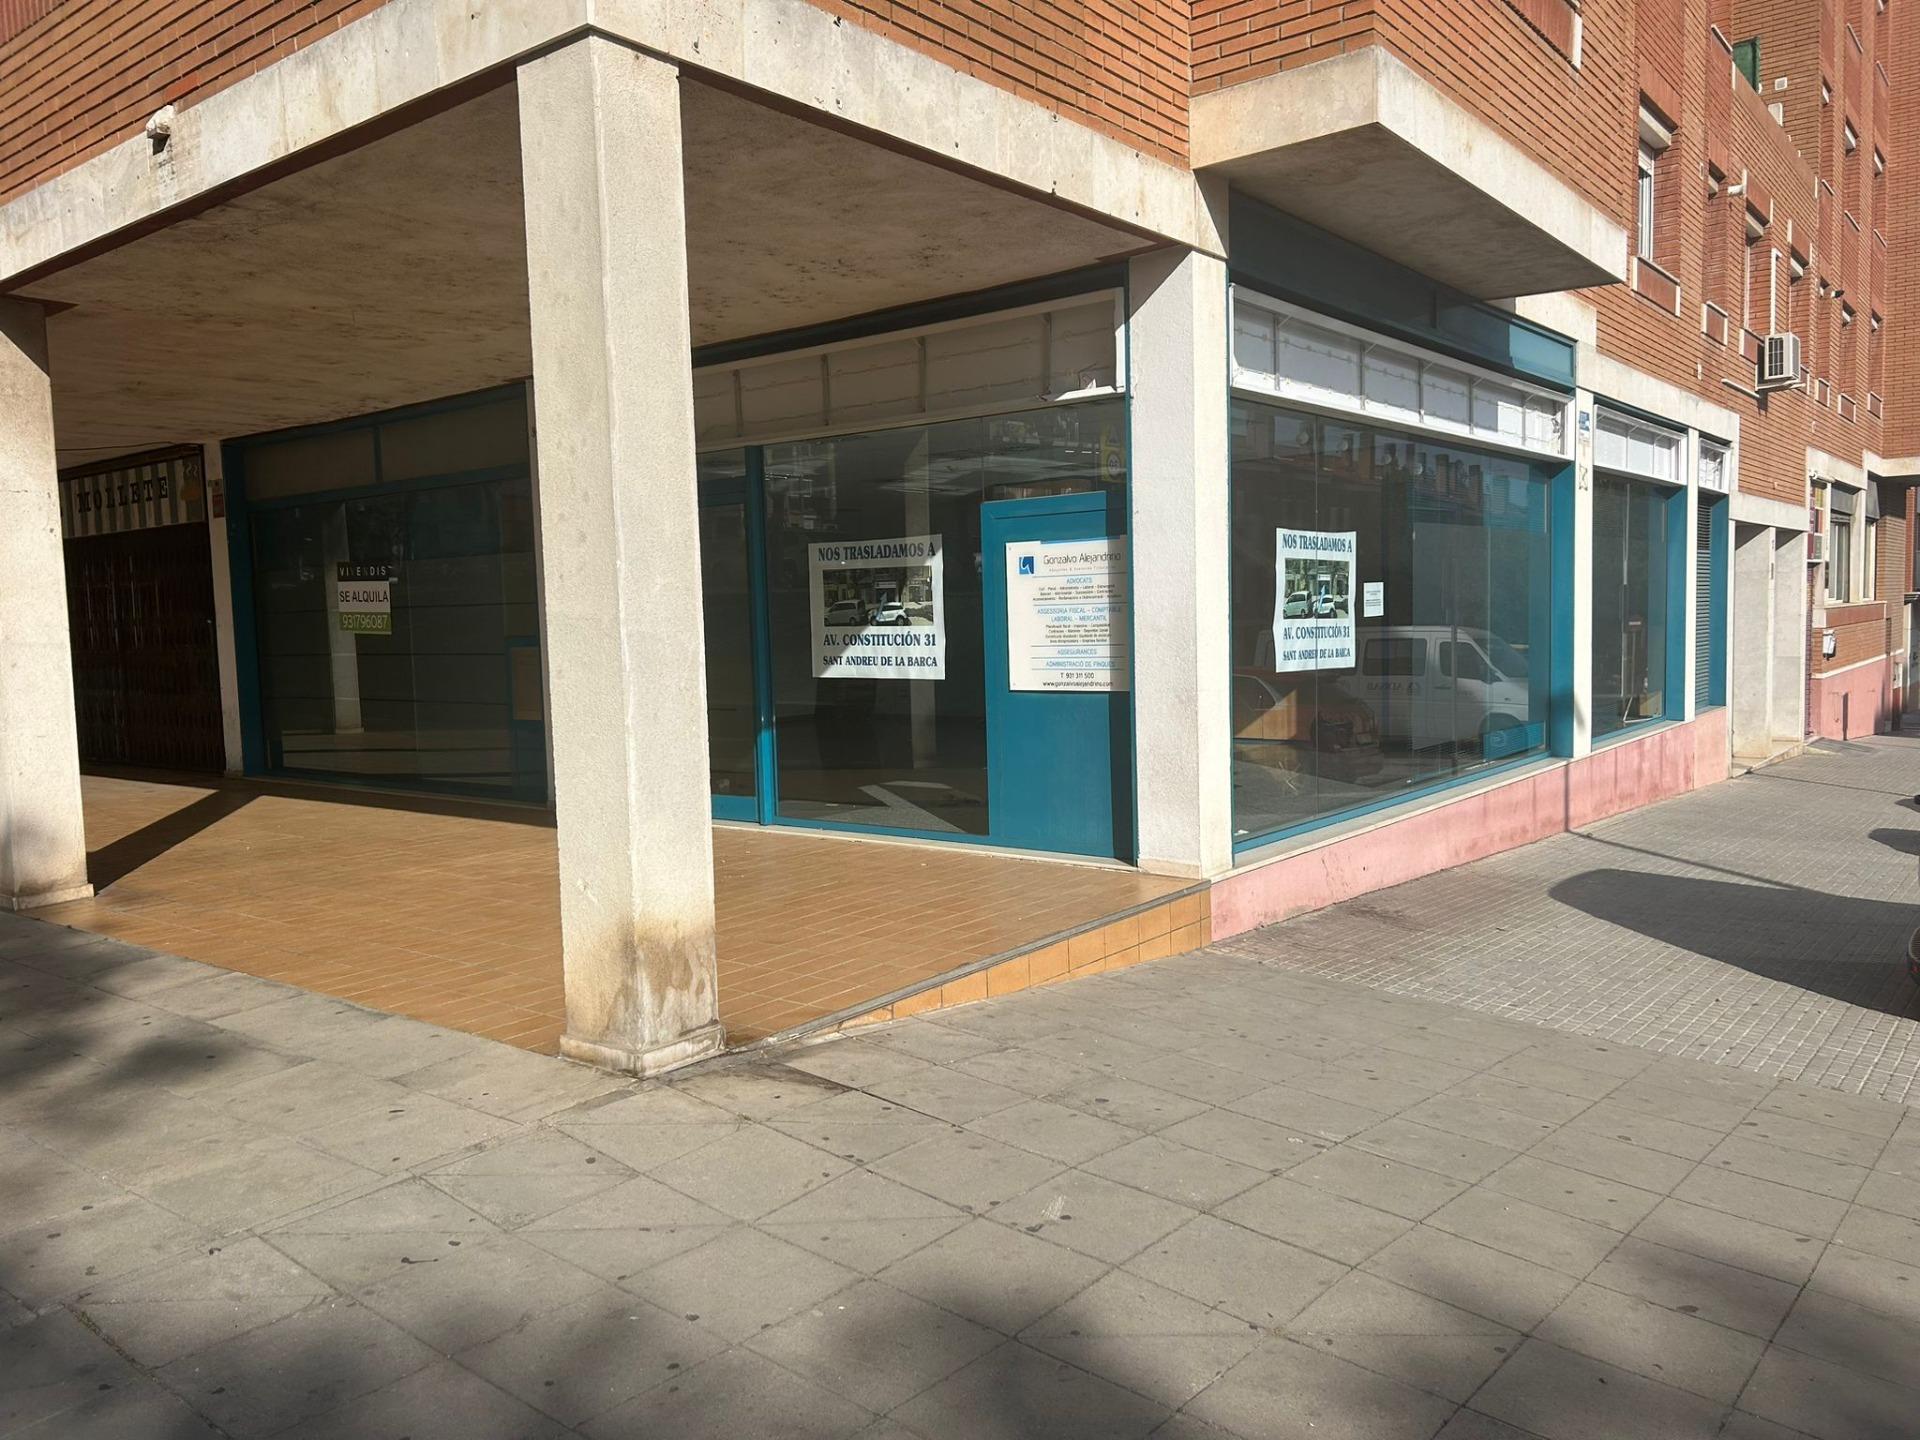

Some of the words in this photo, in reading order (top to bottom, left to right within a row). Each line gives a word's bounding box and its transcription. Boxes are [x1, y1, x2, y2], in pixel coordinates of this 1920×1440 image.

[77, 476, 169, 514] MOLLETE
[1282, 533, 1297, 549] NOS
[1299, 535, 1346, 552] TRASLADAMOS
[1347, 539, 1352, 553] A
[818, 547, 841, 561] NOS
[843, 543, 924, 560] TRASLADAMOS
[927, 541, 936, 557] A
[1043, 554, 1077, 565] Gonzalvo
[339, 590, 351, 603] SE
[352, 590, 389, 603] ALQUILA
[1069, 606, 1087, 614] FISCAL
[823, 633, 840, 646] AV.
[843, 631, 920, 646] CONSTITUCIÓN
[924, 633, 936, 646] 31
[1283, 627, 1295, 640] AV.
[1295, 623, 1342, 640] CONSTITUCIÓN
[1343, 626, 1350, 638] 31
[823, 655, 843, 666] SANT
[845, 656, 878, 666] ANDREU
[881, 656, 893, 666] DE
[895, 656, 905, 667] LA
[907, 656, 937, 667] BARCA
[1283, 650, 1297, 661] SANT
[1298, 649, 1319, 660] ANDREU
[1320, 649, 1327, 659] DE
[1328, 649, 1334, 658] LA
[1335, 648, 1351, 658] BARCA
